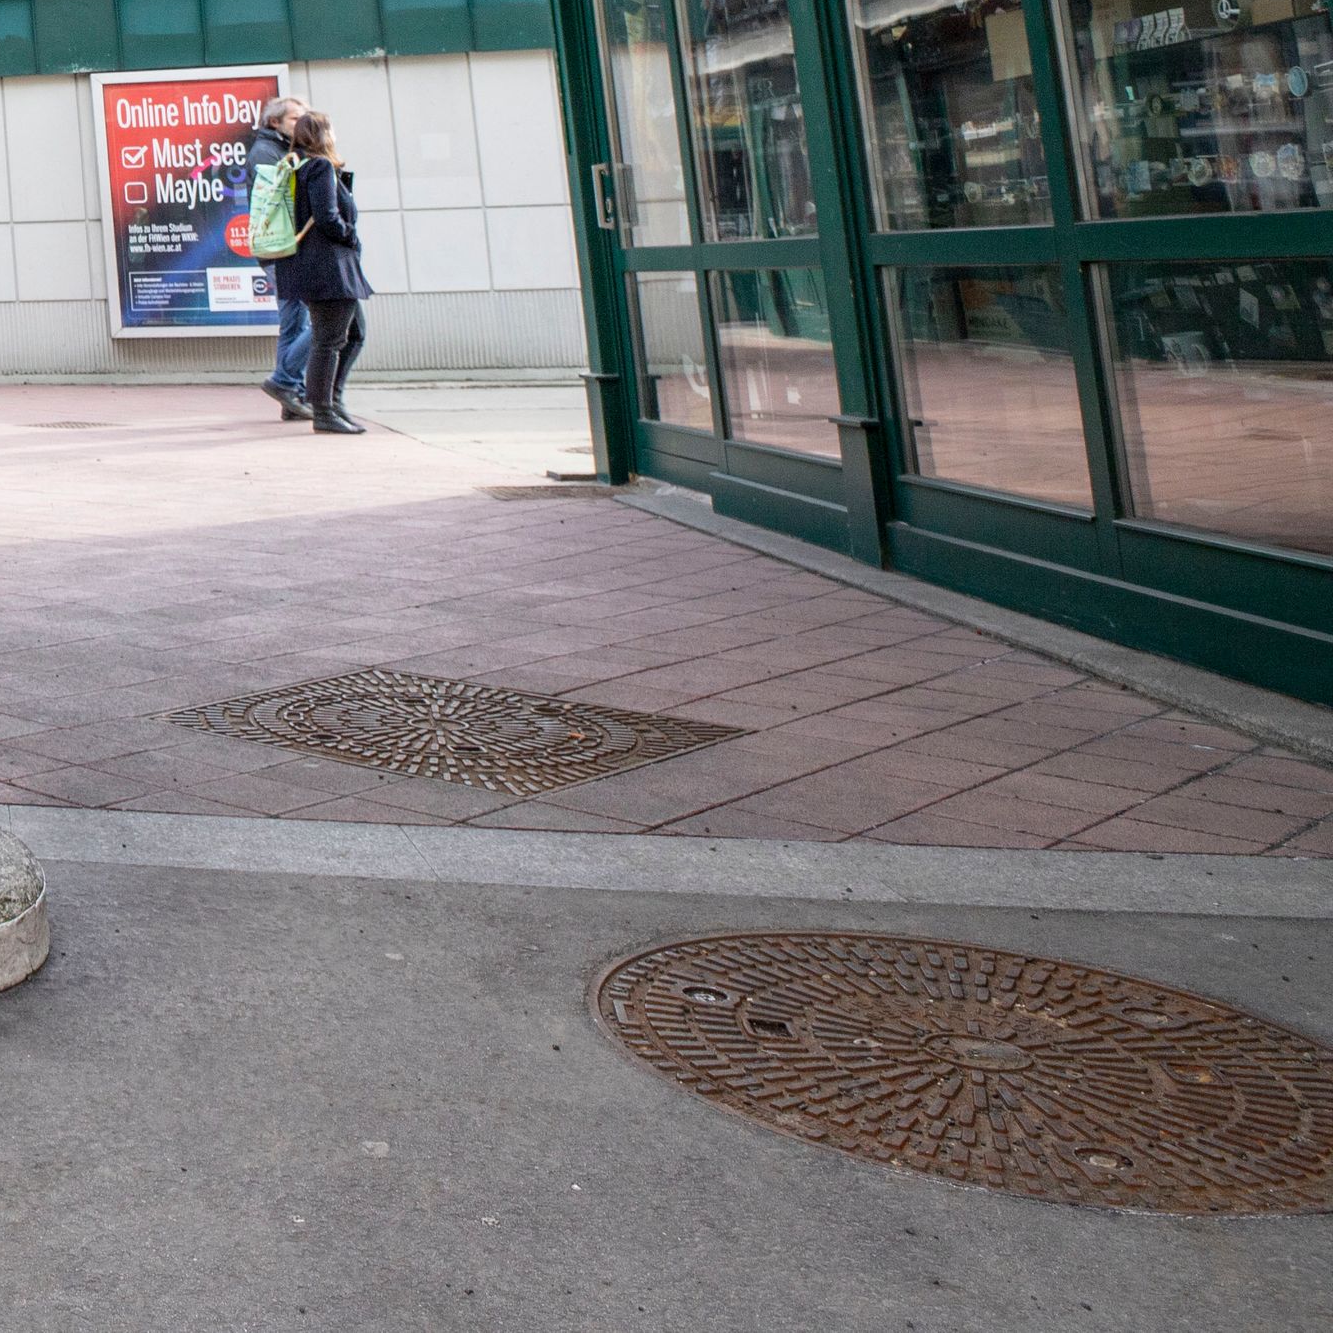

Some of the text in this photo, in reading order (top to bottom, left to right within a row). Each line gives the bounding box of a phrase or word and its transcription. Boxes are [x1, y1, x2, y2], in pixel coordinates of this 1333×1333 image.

[116, 93, 262, 131] Online Info Day
[152, 137, 247, 169] Must see
[155, 172, 224, 210] Maybe
[169, 222, 193, 233] Studium
